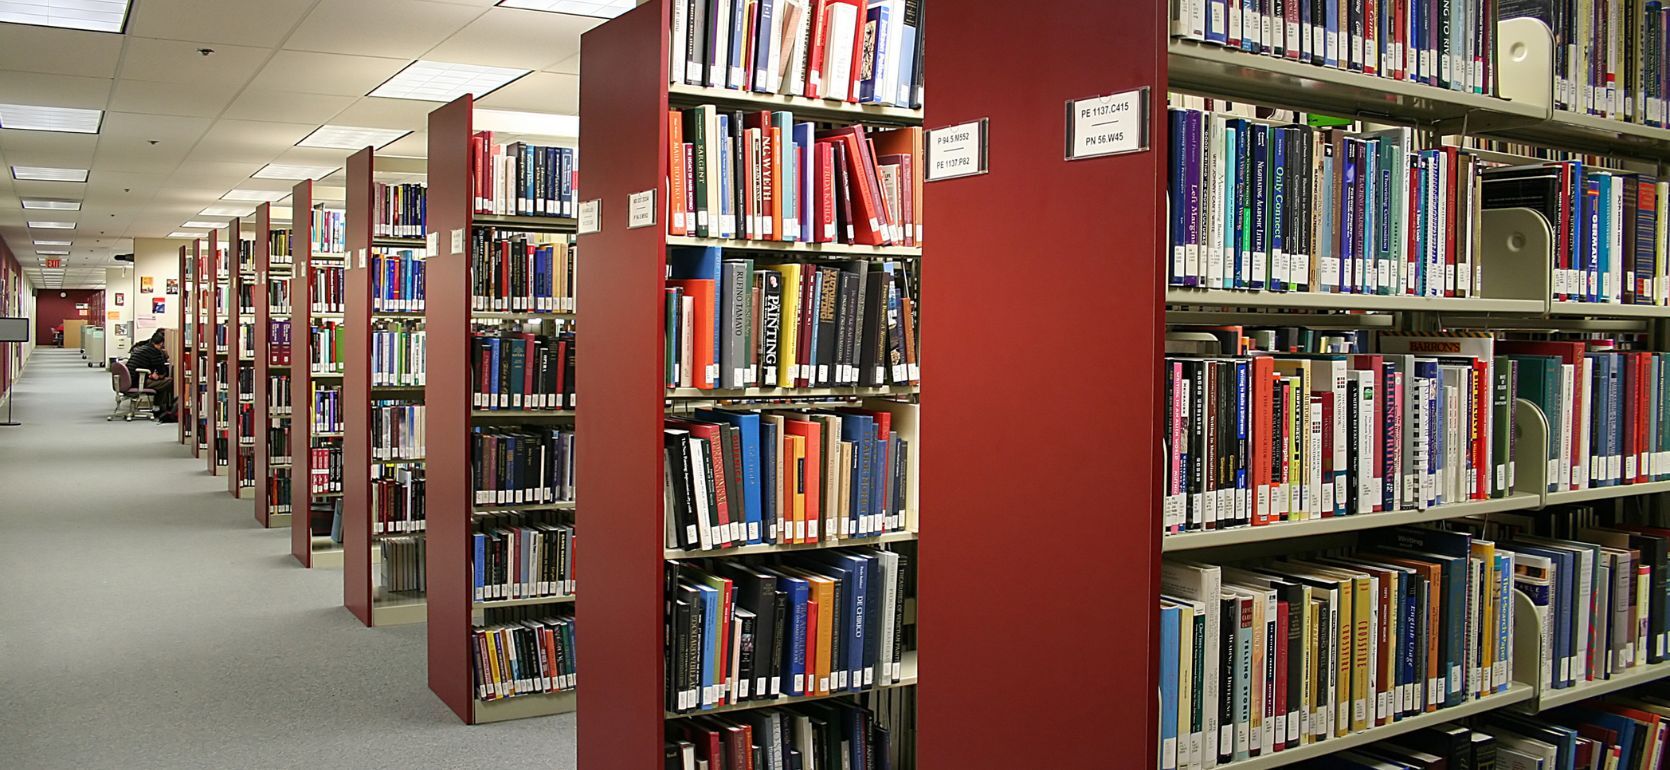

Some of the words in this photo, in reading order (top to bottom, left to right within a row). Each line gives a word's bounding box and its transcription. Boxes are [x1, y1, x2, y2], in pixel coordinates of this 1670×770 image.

[1443, 20, 1450, 34] TO
[1081, 108, 1091, 118] PE
[1093, 102, 1129, 116] 1137.C415
[1086, 136, 1096, 146] PN
[1098, 132, 1124, 144] 56.W45
[697, 145, 705, 184] SARGENT
[763, 158, 772, 201] WYETH
[936, 161, 944, 169] PE
[946, 157, 969, 168] 1137.P82
[1275, 166, 1284, 192] Only
[1217, 174, 1225, 221] Mainstreaming
[1189, 206, 1198, 244] Margins
[1274, 194, 1283, 238] Connect
[735, 271, 743, 301] RUFINO
[820, 269, 831, 320] PAINTING
[828, 270, 837, 320] VICTORIAN
[735, 303, 743, 336] TAMAYO
[766, 295, 780, 364] PAINTING
[1409, 341, 1461, 352] BARRON'S
[1175, 407, 1180, 417] AN
[1386, 372, 1394, 423] TELLING
[1386, 425, 1394, 482] WRITING
[799, 602, 807, 617] FRA
[856, 596, 863, 606] DE
[897, 604, 902, 612] OF
[1322, 608, 1327, 620] ON
[855, 607, 863, 638] CHIRICO
[1408, 605, 1416, 639] English
[798, 619, 806, 665] ANGELICO
[1341, 624, 1350, 672] CROSSFIRE
[1357, 620, 1368, 668] CROSSFIRE
[1406, 641, 1415, 667] Usage
